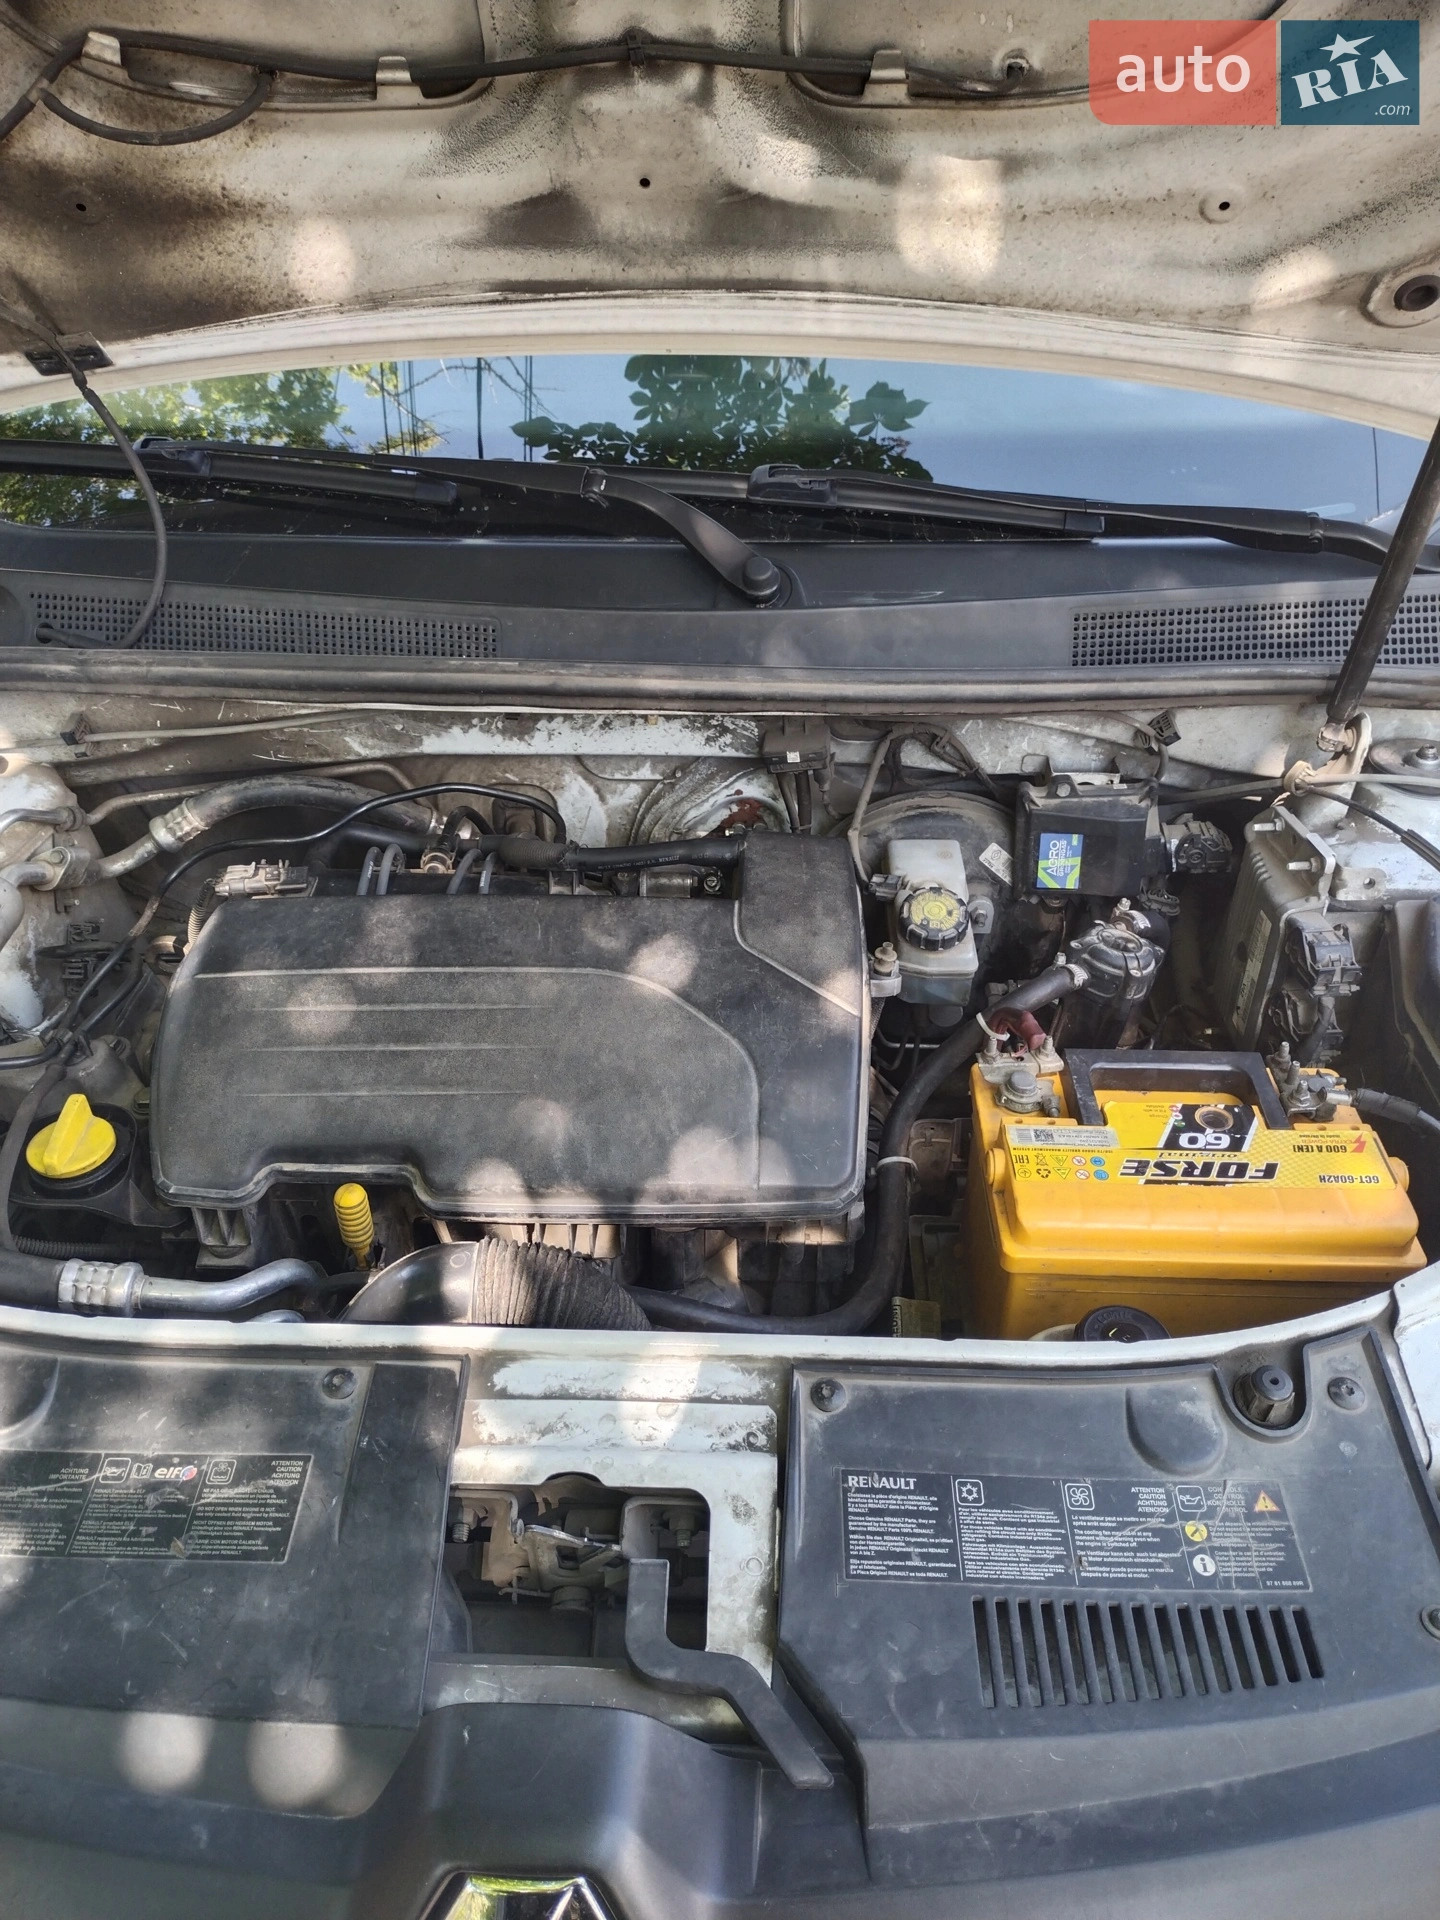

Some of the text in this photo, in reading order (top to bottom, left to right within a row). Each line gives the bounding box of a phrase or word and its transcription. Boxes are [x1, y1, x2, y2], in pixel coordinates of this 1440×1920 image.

[1178, 1133, 1230, 1149] 60
[1326, 1145, 1347, 1153] 600
[1118, 1159, 1278, 1179] FORSE
[848, 1475, 916, 1490] RENAULT
